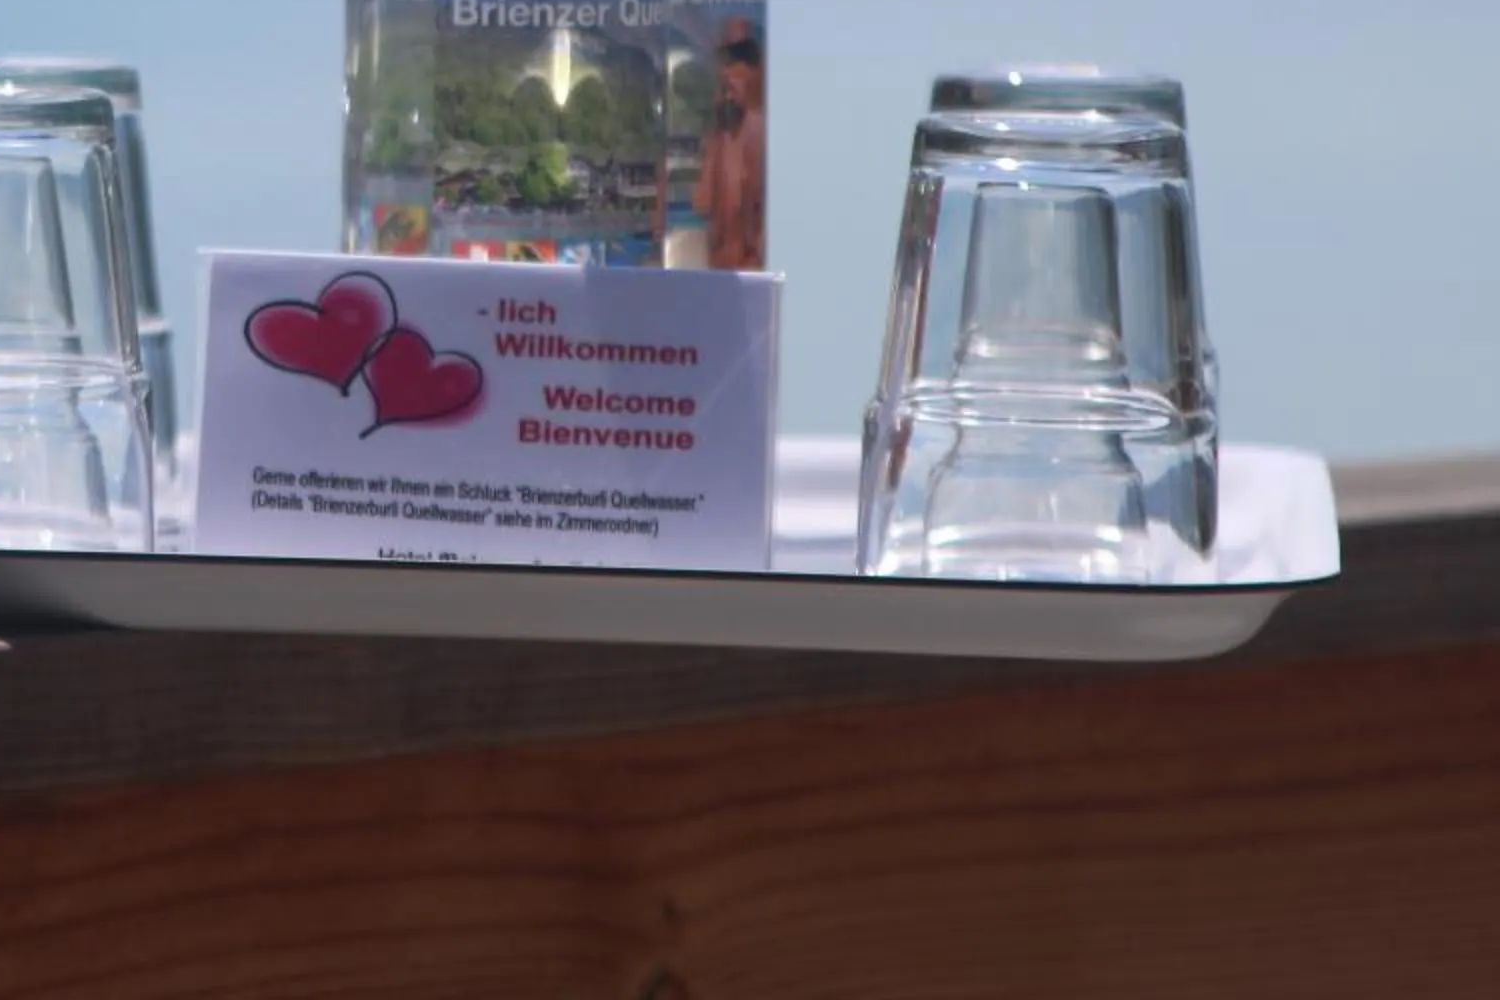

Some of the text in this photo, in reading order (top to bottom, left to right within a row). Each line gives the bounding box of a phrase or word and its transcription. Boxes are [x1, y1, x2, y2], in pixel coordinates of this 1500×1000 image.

[498, 298, 557, 325] lich
[495, 332, 698, 366] Willkommen
[543, 384, 696, 417] Welcome
[518, 417, 695, 451] Bienvenue
[252, 465, 296, 487] Gerne
[299, 470, 365, 491] offerieren
[367, 475, 388, 493] wir
[391, 477, 431, 497] Ihnen
[434, 481, 455, 498] ein
[457, 481, 512, 502] Schluck
[251, 489, 303, 512] (Details
[495, 509, 533, 529] siehe
[536, 514, 553, 530] im
[556, 512, 659, 538] Zimmerordner)
